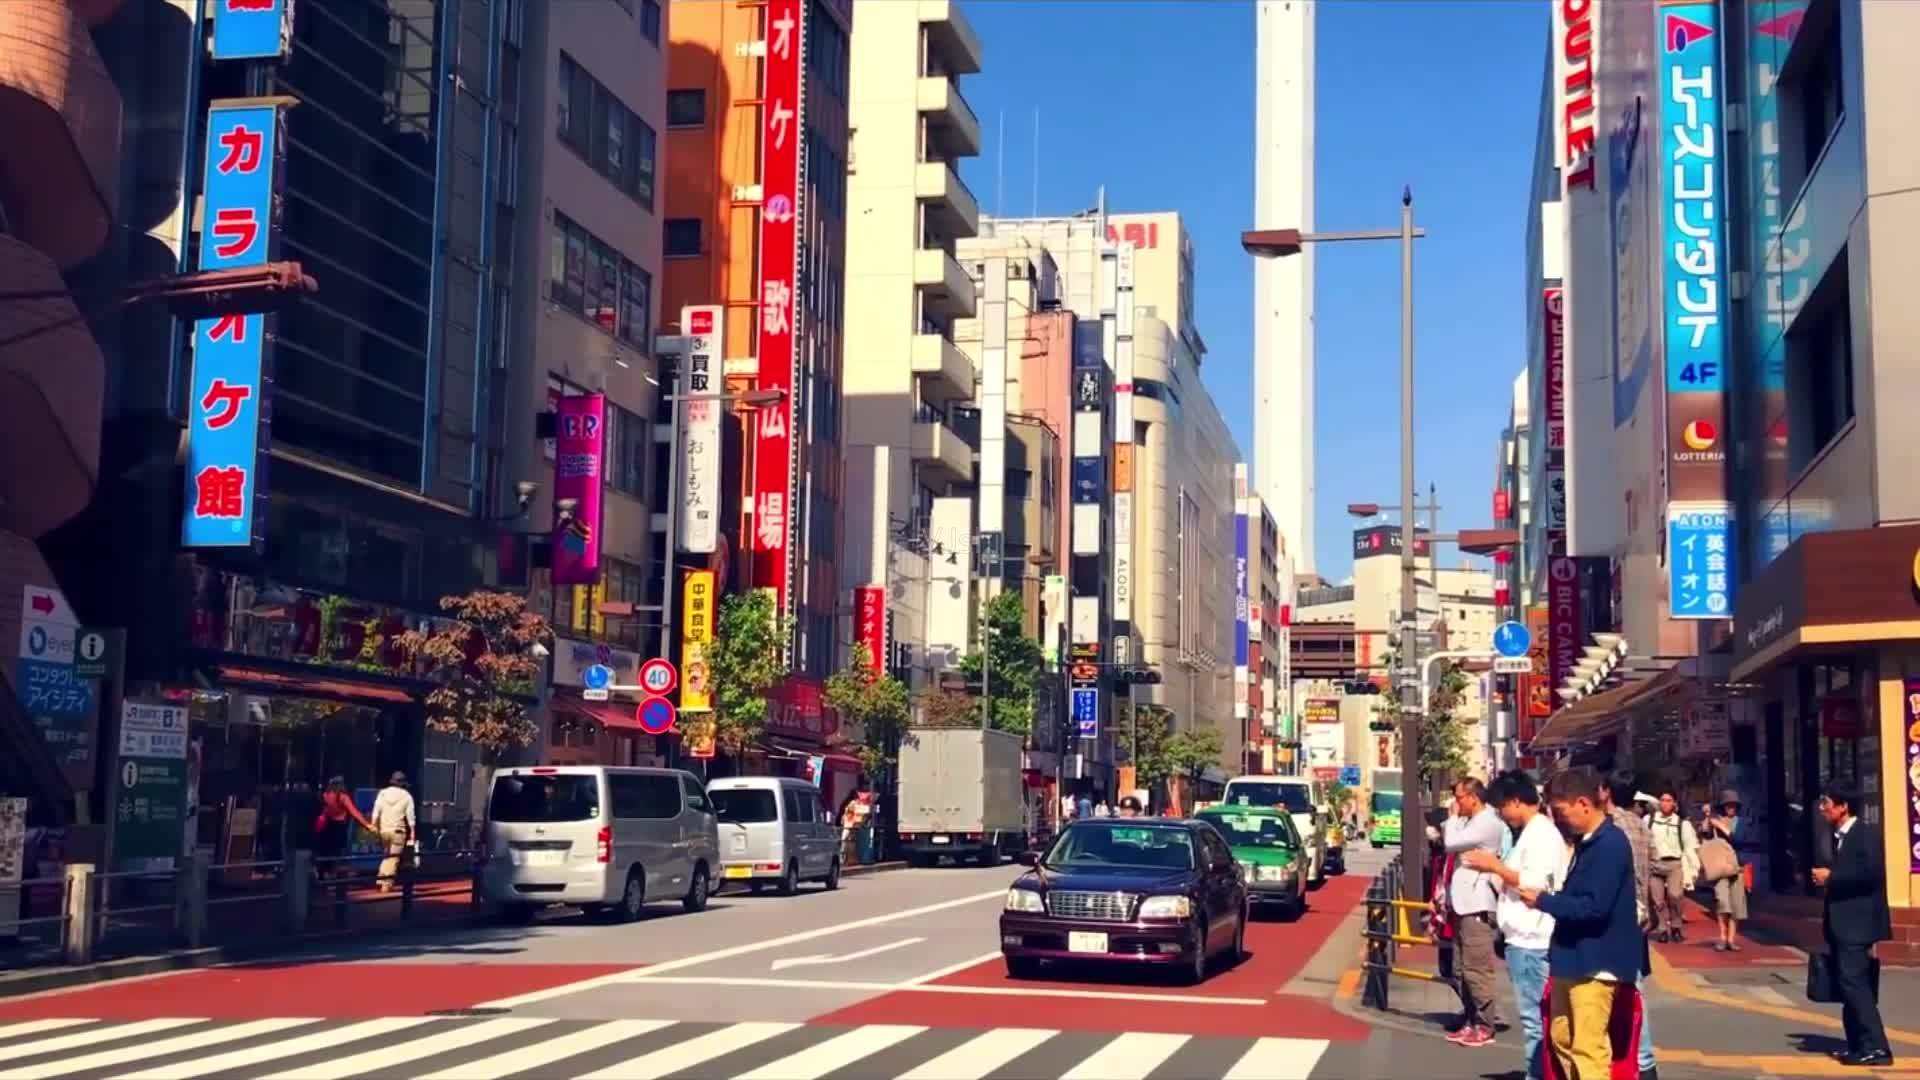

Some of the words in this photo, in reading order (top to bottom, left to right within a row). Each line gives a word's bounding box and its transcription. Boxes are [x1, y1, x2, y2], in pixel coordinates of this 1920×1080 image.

[1671, 65, 1719, 349] エースコンタクト
[690, 354, 710, 392] 買取
[1679, 362, 1718, 385] 4F
[1673, 451, 1726, 462] LOTTERIA
[1679, 513, 1726, 528] AEON
[1680, 534, 1701, 609] イーオン
[1705, 533, 1727, 591] 英会話
[1117, 559, 1128, 604] ALOOK
[647, 670, 668, 686] 40
[27, 686, 88, 713] アイシティ
